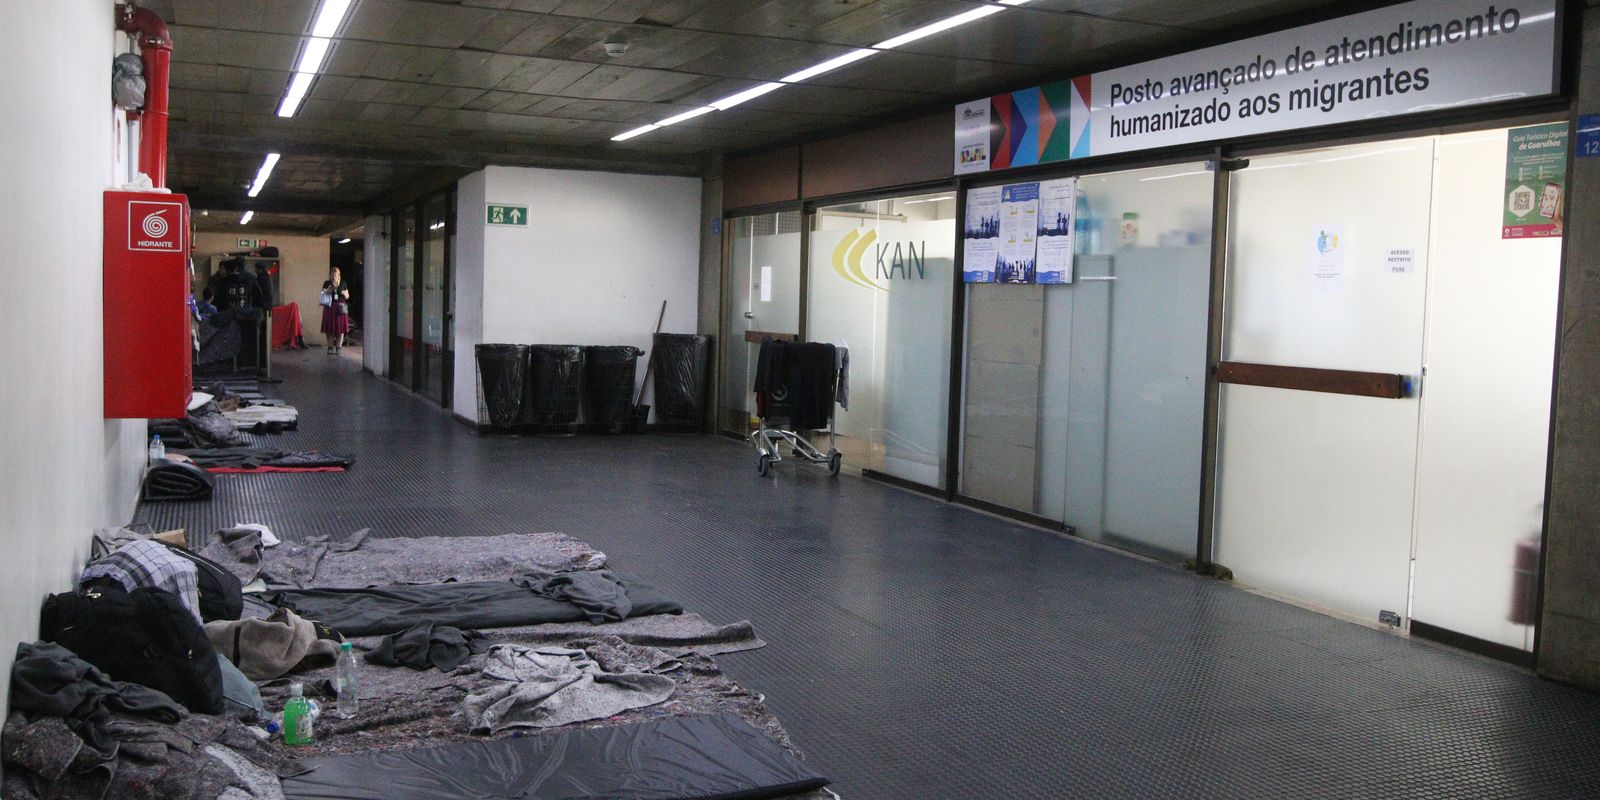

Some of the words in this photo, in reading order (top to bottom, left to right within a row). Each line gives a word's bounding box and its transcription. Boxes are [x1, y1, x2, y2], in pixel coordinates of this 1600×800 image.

[1110, 78, 1164, 108] Posto
[1170, 55, 1277, 95] avançado
[1285, 46, 1316, 76] de
[1324, 5, 1521, 68] atendimento
[1110, 98, 1231, 139] humanizado
[1238, 92, 1281, 119] aos
[1288, 66, 1430, 113] migrantes
[1518, 142, 1528, 150] de
[1528, 140, 1561, 149] Guarulhos
[1549, 130, 1568, 139] Digital
[876, 241, 925, 280] KAN
